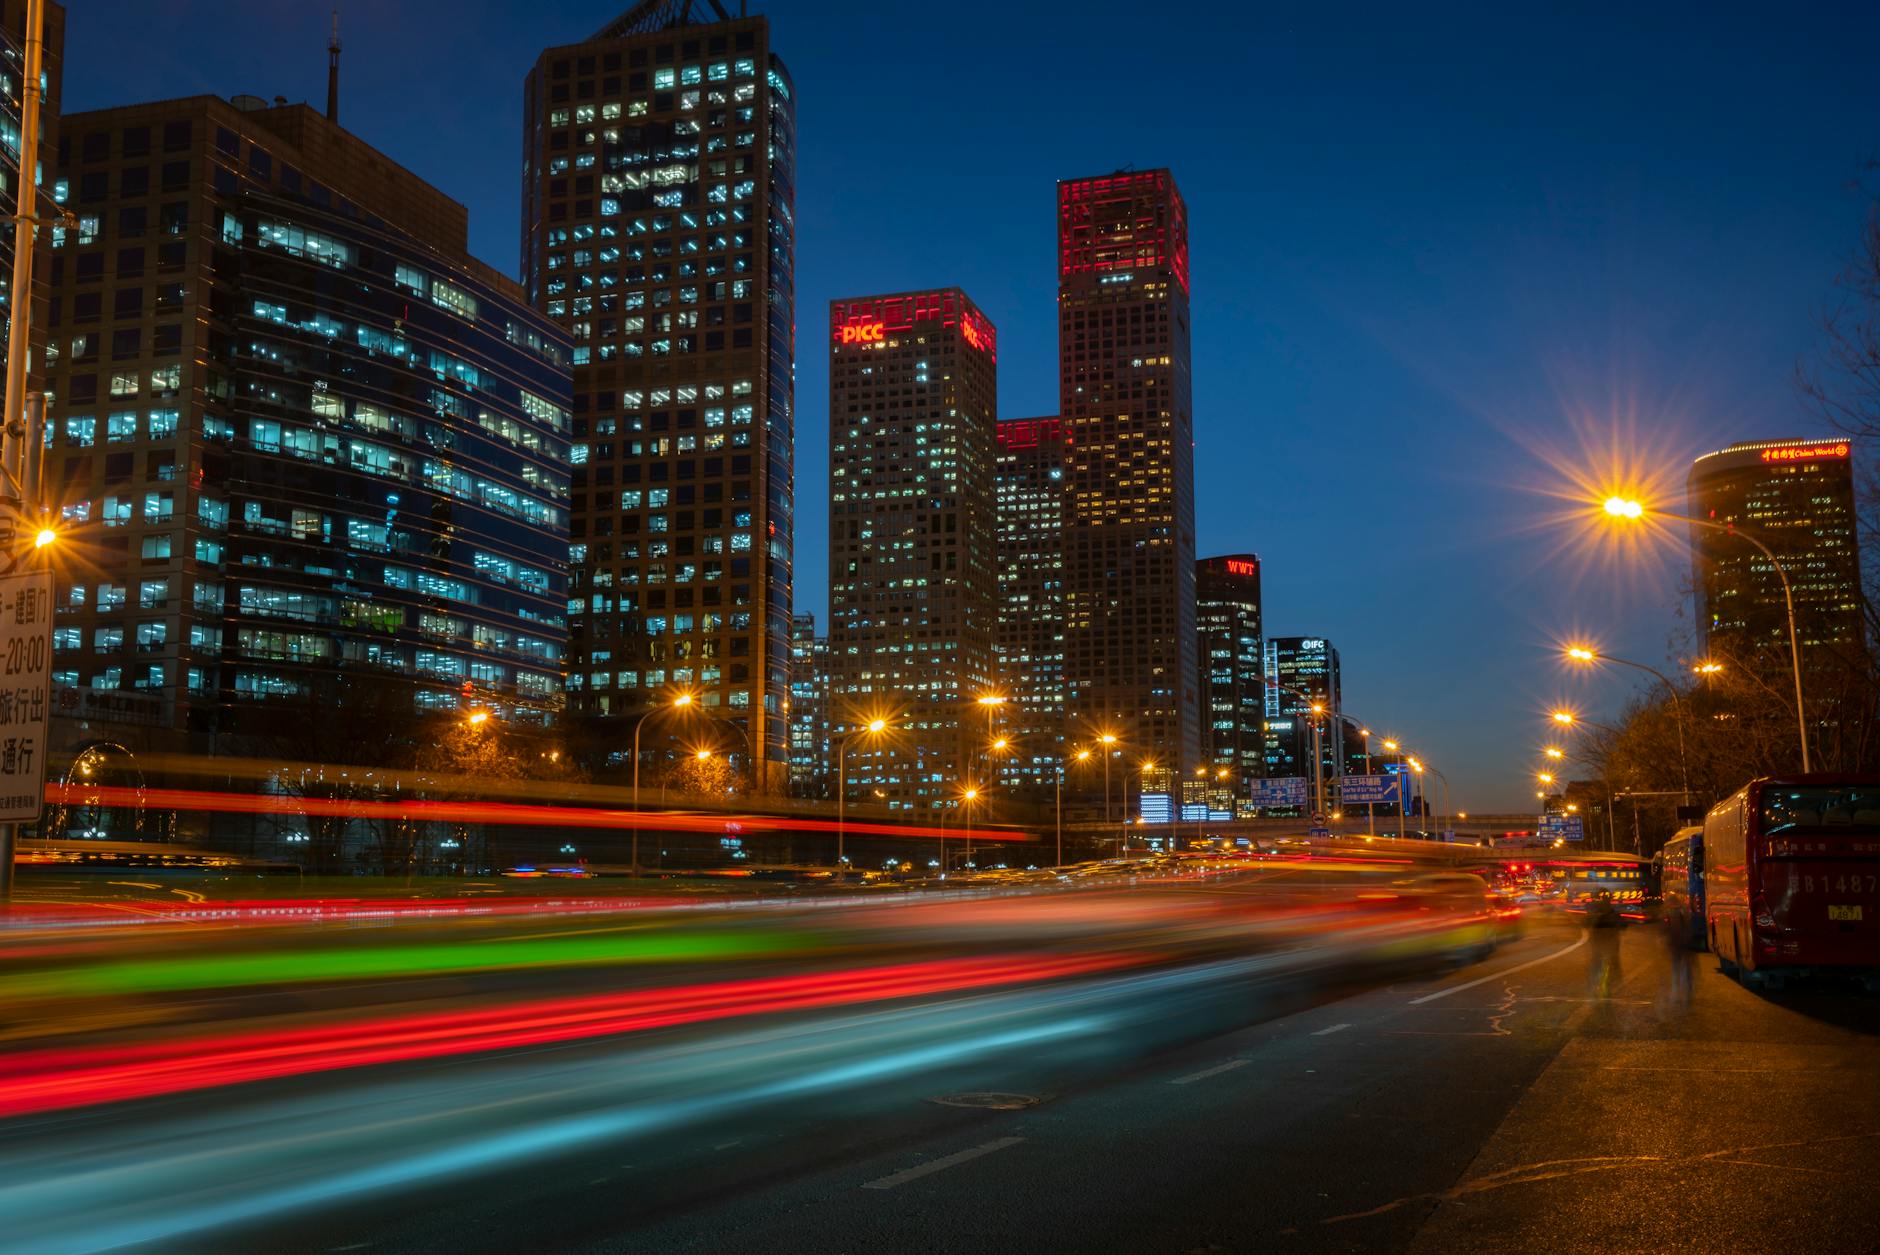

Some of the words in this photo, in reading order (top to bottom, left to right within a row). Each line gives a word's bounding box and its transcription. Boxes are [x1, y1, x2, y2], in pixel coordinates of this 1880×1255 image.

[842, 322, 884, 344] PICC
[1815, 448, 1835, 456] World
[1227, 560, 1255, 576] WWT
